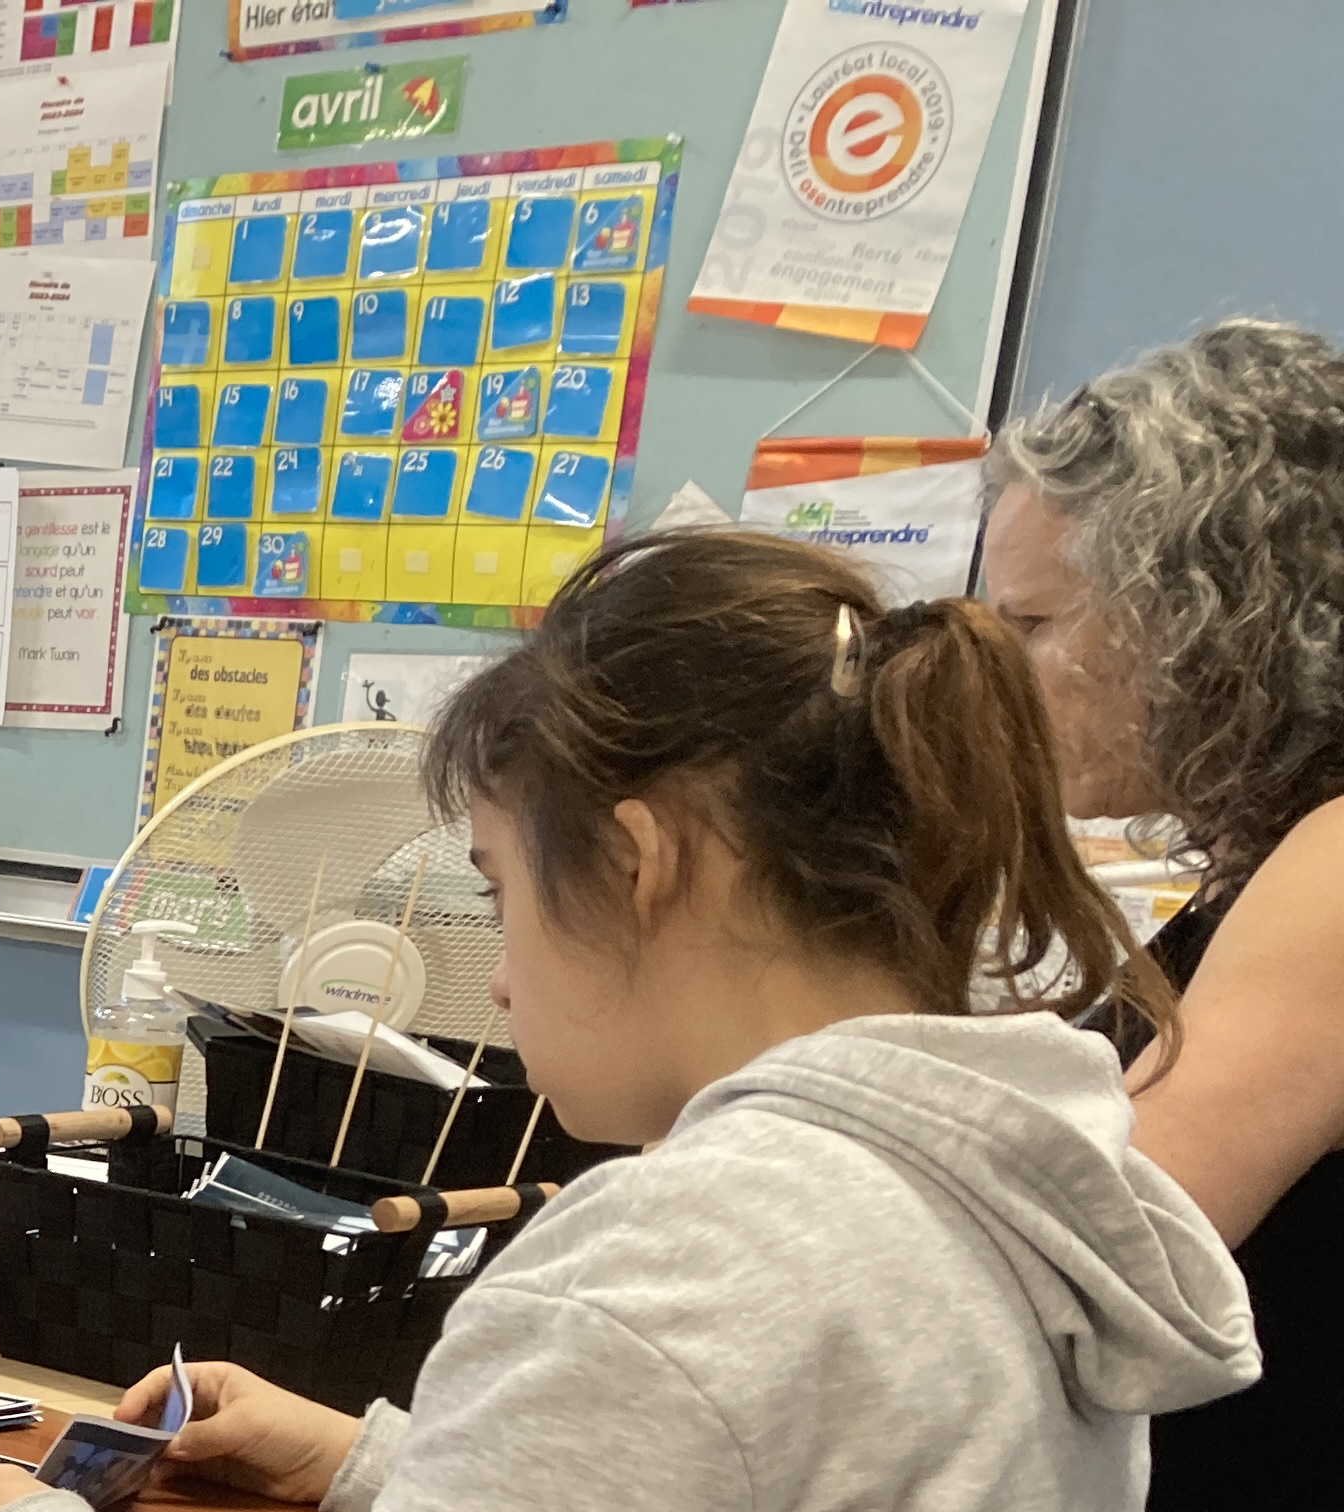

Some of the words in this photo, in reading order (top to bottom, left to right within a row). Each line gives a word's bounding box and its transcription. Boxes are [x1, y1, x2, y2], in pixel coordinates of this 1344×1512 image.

[246, 4, 283, 30] Hier
[291, 0, 333, 23] étai
[292, 74, 384, 129] avril
[808, 52, 873, 112] Lauréat
[880, 51, 928, 85] local
[921, 80, 945, 130] 2019
[180, 201, 232, 219] dimanche
[252, 197, 282, 213] lundi
[315, 192, 351, 209] mardi
[373, 187, 430, 204] mercredi
[456, 178, 491, 197] jeudi
[516, 173, 577, 192] vendredi
[594, 166, 648, 185] samedi
[241, 221, 249, 241] 1
[303, 215, 318, 236] 2
[438, 202, 450, 225] 4
[519, 199, 533, 222] 5
[585, 205, 599, 225] 6
[770, 262, 896, 295] engagement
[168, 304, 177, 323] 7
[232, 300, 242, 320] 8
[293, 301, 305, 323] 9
[358, 294, 379, 315] 10
[430, 298, 447, 320] 11
[499, 282, 520, 304] 12
[571, 285, 590, 305] 13
[159, 388, 174, 408] 14
[225, 386, 241, 405] 15
[284, 381, 299, 400] 16
[354, 371, 371, 392] 17
[412, 375, 429, 395] 18
[487, 374, 505, 396] 19
[556, 368, 587, 389] 20
[157, 459, 174, 478] 21
[213, 457, 234, 477] 22
[277, 451, 298, 471] 24
[404, 451, 430, 472] 25
[481, 449, 506, 471] 26
[553, 454, 580, 476] 27
[25, 522, 79, 538] gentillesse
[81, 522, 99, 535] est
[101, 521, 111, 535] le
[147, 529, 167, 548] 28
[201, 526, 222, 546] 29
[262, 535, 285, 555] 30
[63, 543, 96, 558] qu'un
[25, 564, 57, 577] sourd
[59, 564, 86, 580] peut
[13, 585, 53, 598] ntendre
[55, 586, 67, 598] et
[70, 584, 104, 600] qu'un
[48, 607, 73, 622] peut
[18, 647, 47, 661] Mark
[50, 647, 80, 661] Twain
[190, 664, 210, 681] des
[214, 665, 268, 684] obstacles
[185, 703, 208, 719] des
[214, 704, 261, 722] doutes
